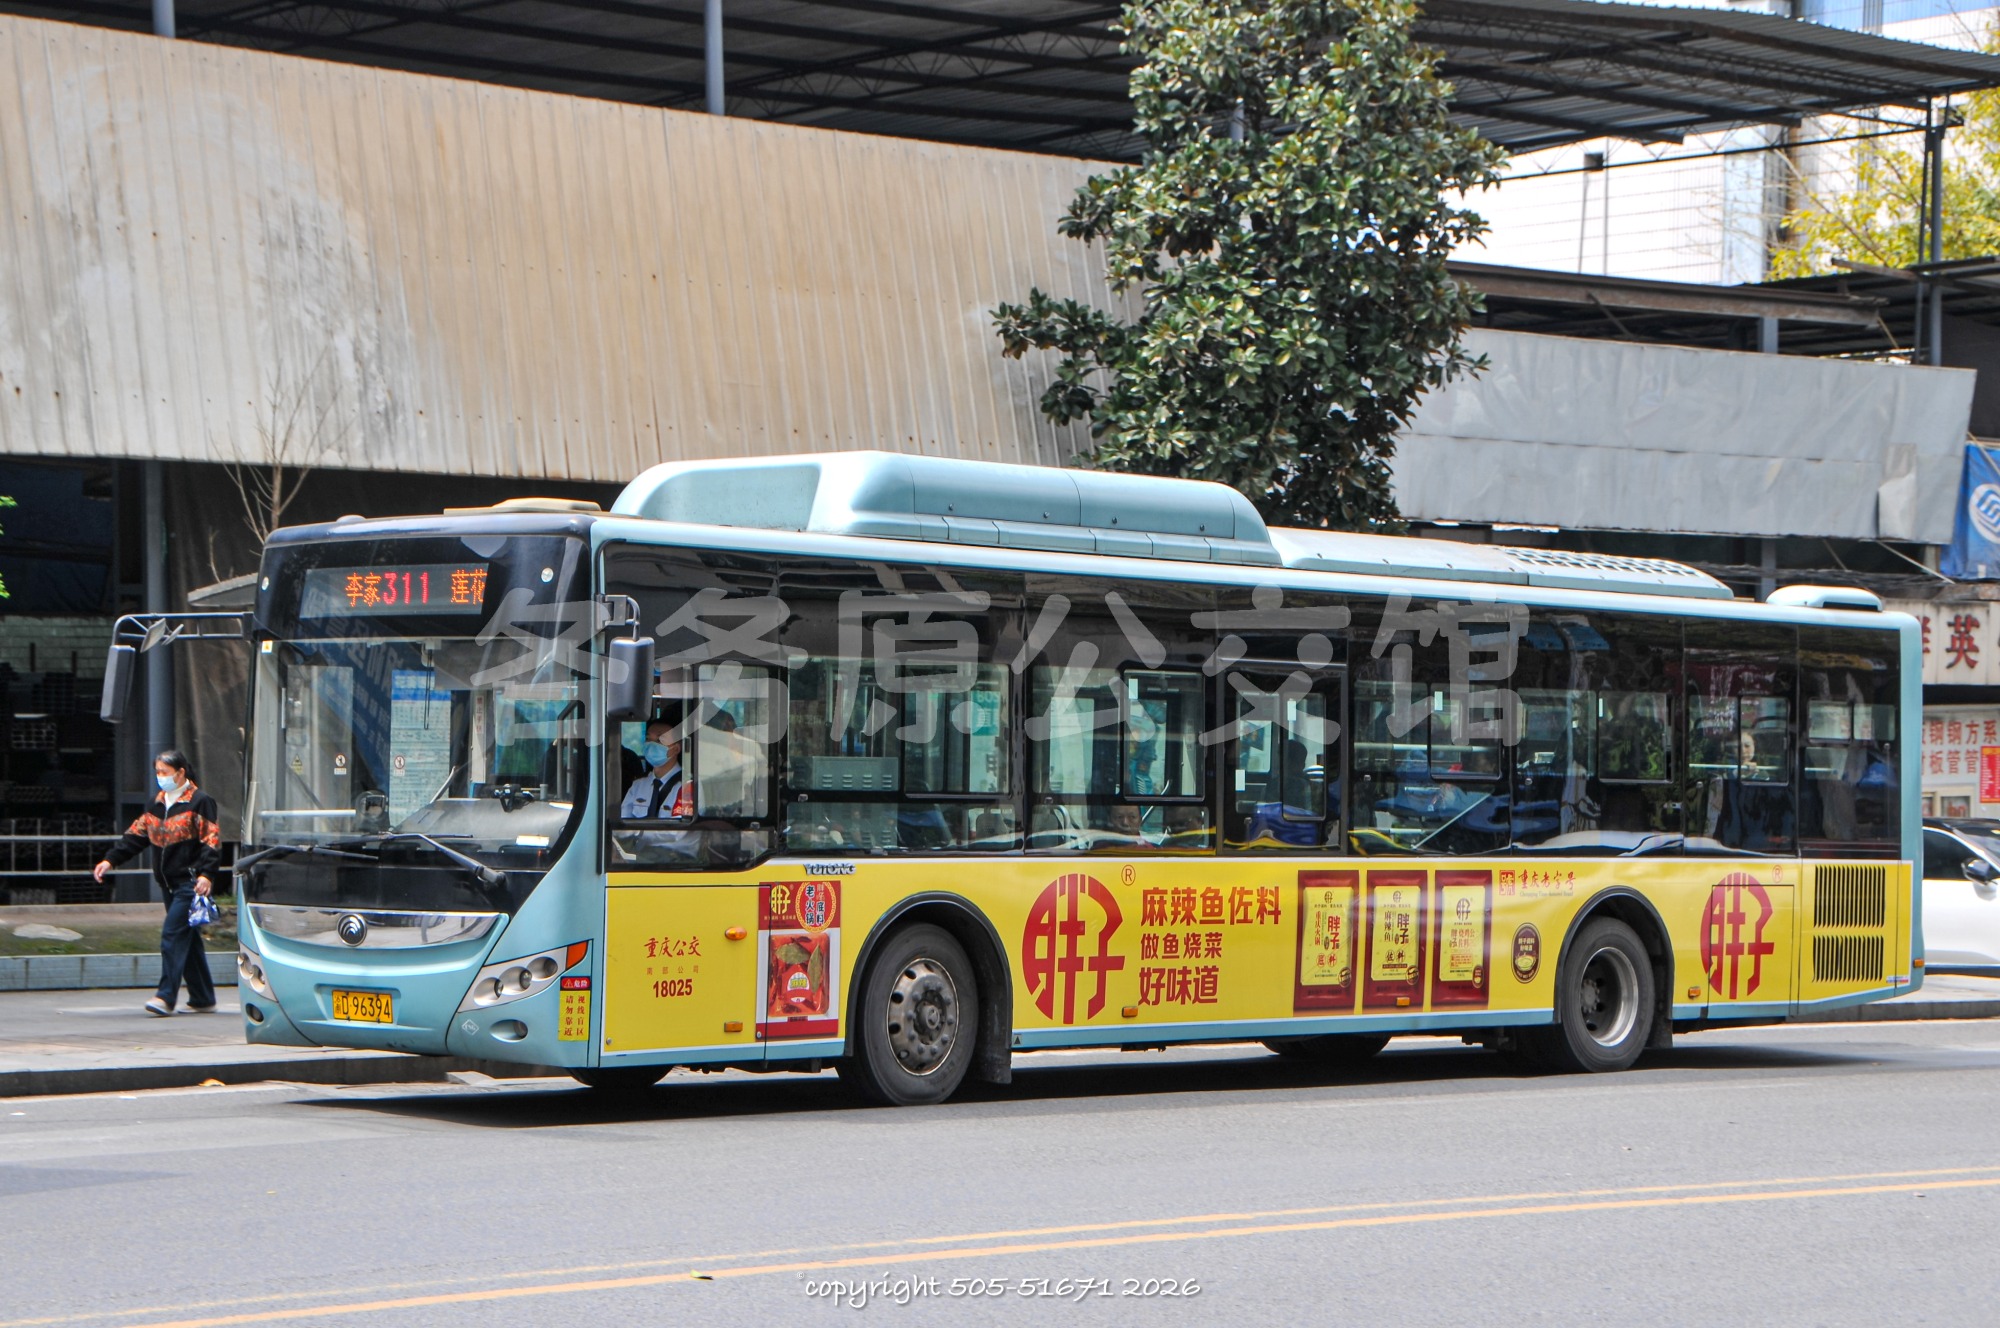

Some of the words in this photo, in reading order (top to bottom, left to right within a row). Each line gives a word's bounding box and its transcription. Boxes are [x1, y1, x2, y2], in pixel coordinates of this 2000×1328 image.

[345, 573, 381, 607] 李家
[383, 572, 428, 604] 311
[451, 568, 487, 605] 莲花
[803, 863, 856, 876] YUTONG
[1518, 869, 1576, 891] 重庆老字号
[805, 885, 815, 925] 老火锅
[1141, 886, 1281, 926] 麻辣鱼佐料
[1327, 915, 1341, 950] 胖子
[1397, 913, 1410, 945] 胖子
[644, 936, 701, 958] 重庆公交
[1140, 932, 1223, 960] 做鱼烧菜
[574, 980, 588, 988] 危险
[653, 979, 692, 998] 18025
[1138, 965, 1220, 1006] 好味道
[564, 995, 574, 1036] 请勿靠近
